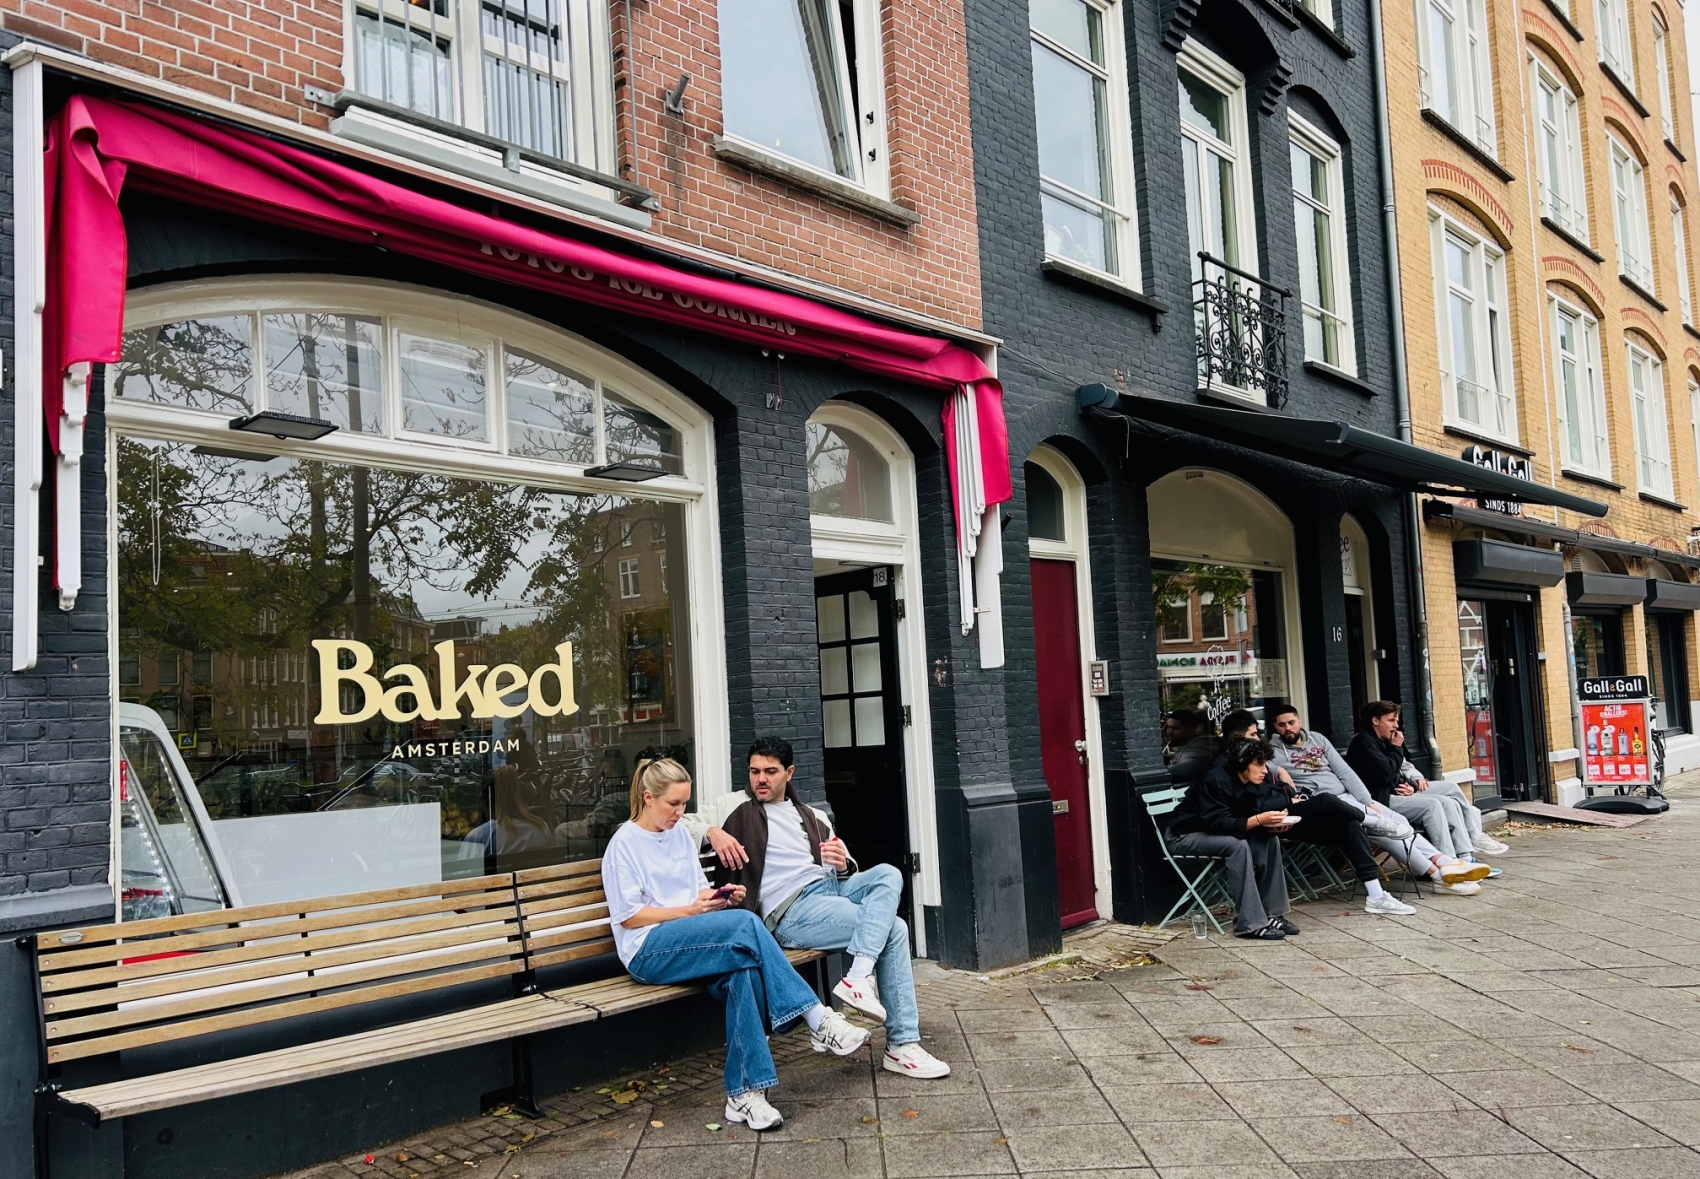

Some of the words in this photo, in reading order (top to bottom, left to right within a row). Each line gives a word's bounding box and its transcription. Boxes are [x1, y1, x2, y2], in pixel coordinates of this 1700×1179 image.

[1485, 499, 1505, 512] SINDS
[874, 571, 886, 583] 18
[1332, 626, 1342, 642] 16
[312, 640, 580, 725] Baked
[1207, 695, 1232, 721] Coffee
[391, 738, 521, 759] AMSTERDAM
